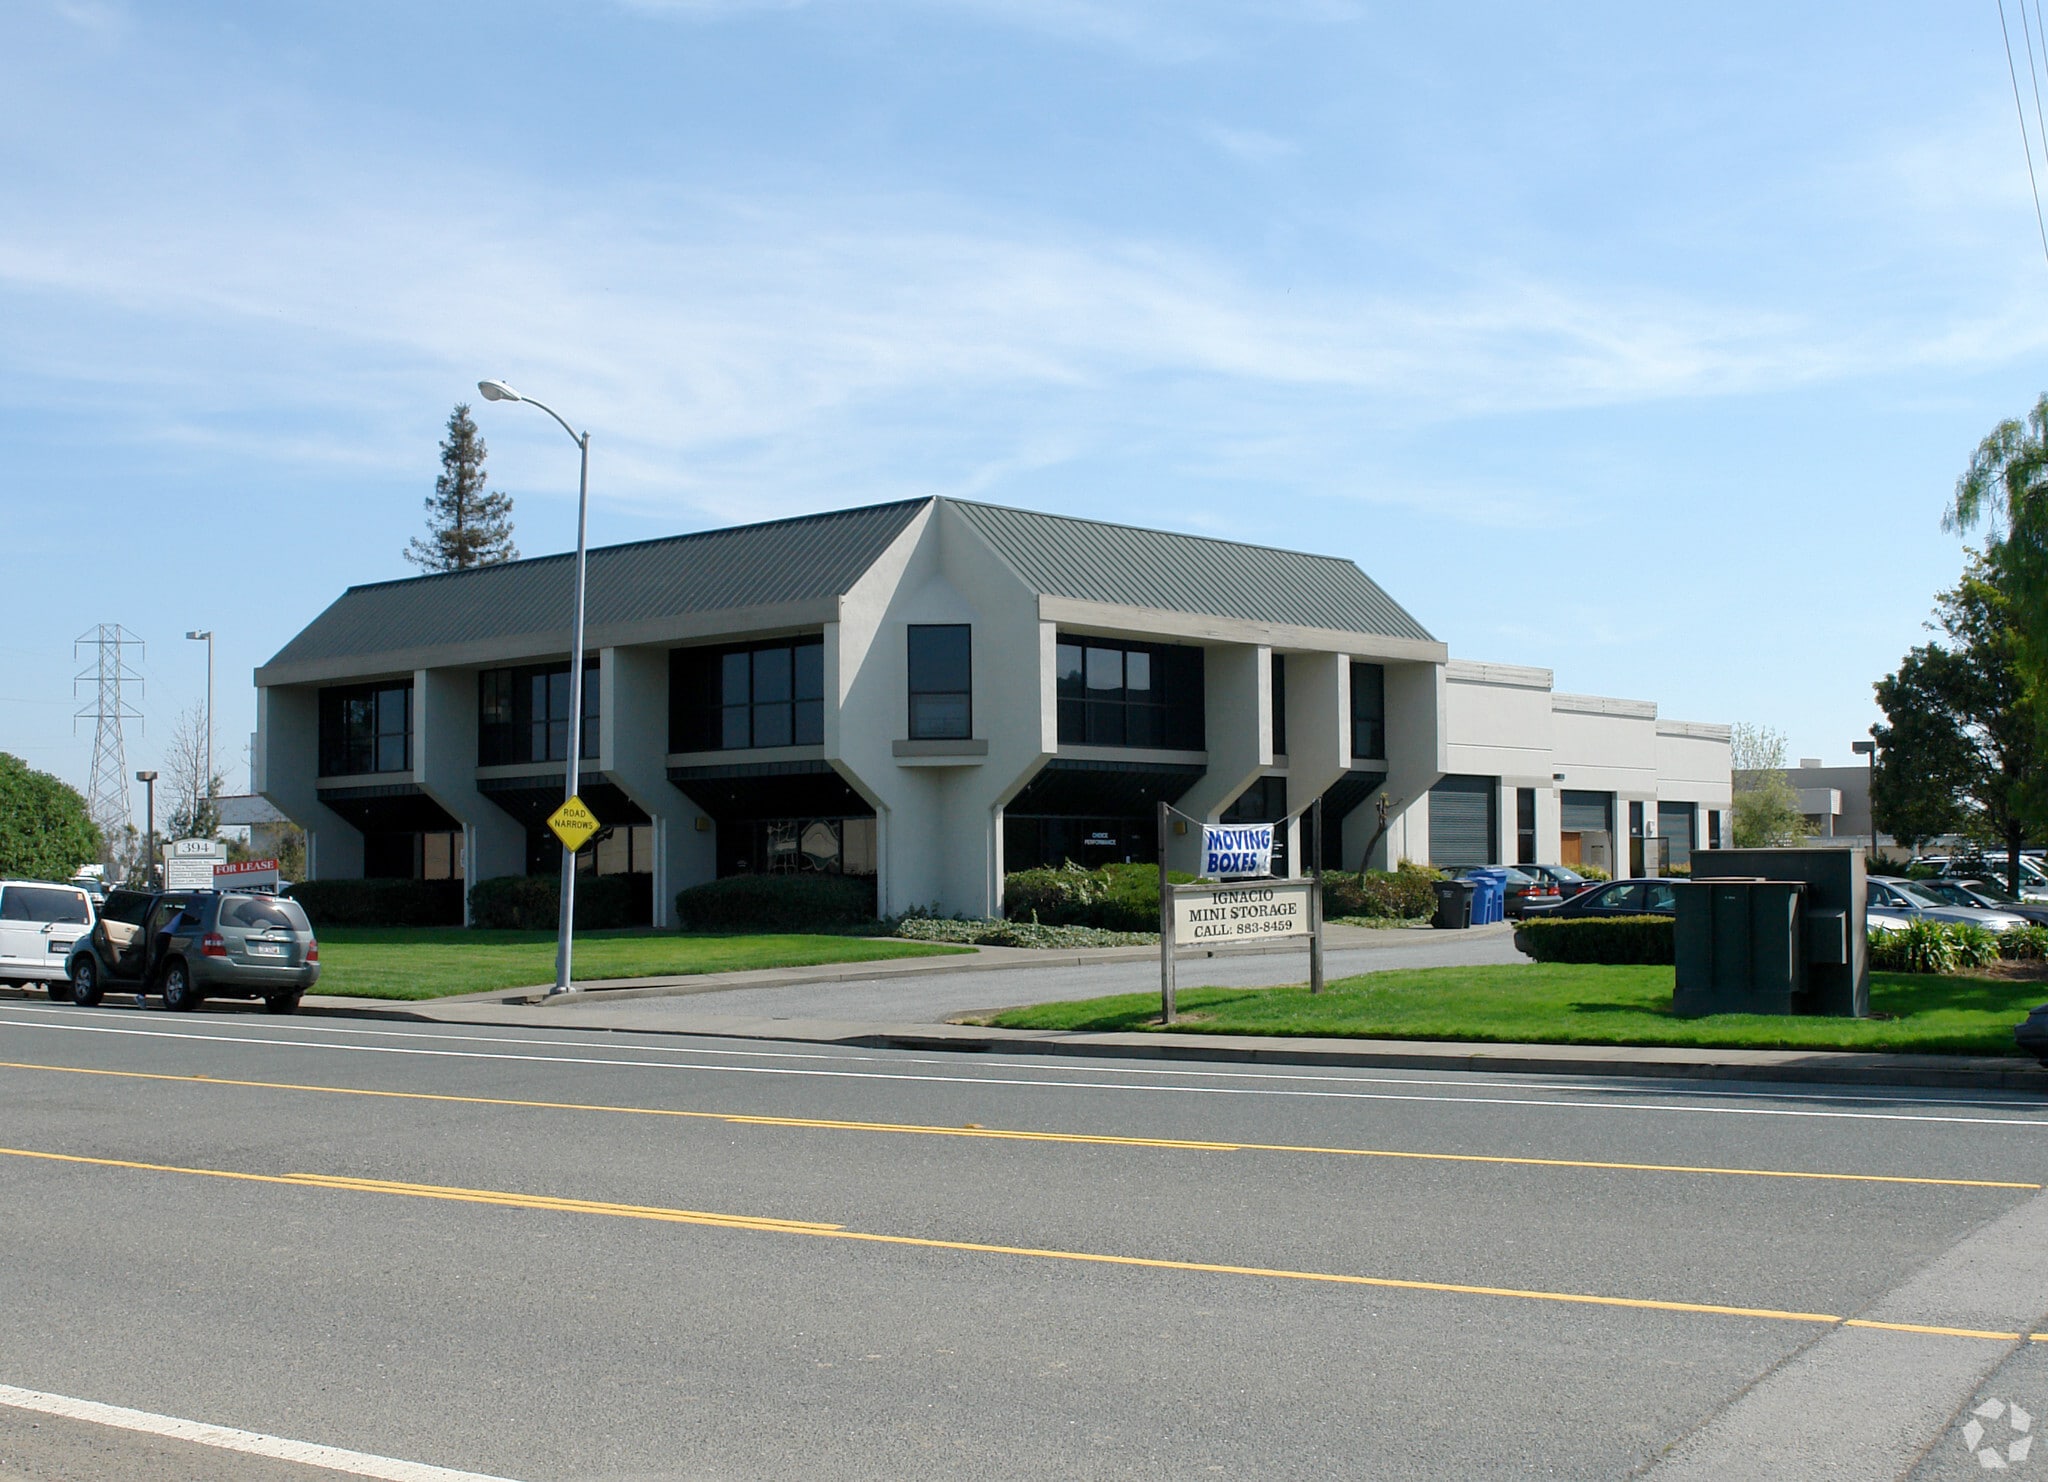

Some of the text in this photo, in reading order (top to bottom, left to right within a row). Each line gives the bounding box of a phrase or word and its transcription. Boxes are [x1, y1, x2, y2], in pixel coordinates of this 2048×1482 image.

[563, 808, 586, 818] ROAD
[554, 819, 593, 830] NARROWS
[182, 842, 209, 853] 394
[1207, 829, 1270, 851] MOVING
[215, 865, 237, 875] FOR
[240, 860, 274, 871] LEASE
[1212, 889, 1274, 905] IGNACIO
[1189, 903, 1297, 922] MINI STORAGE
[1194, 919, 1293, 938] CALL: 883-8459
